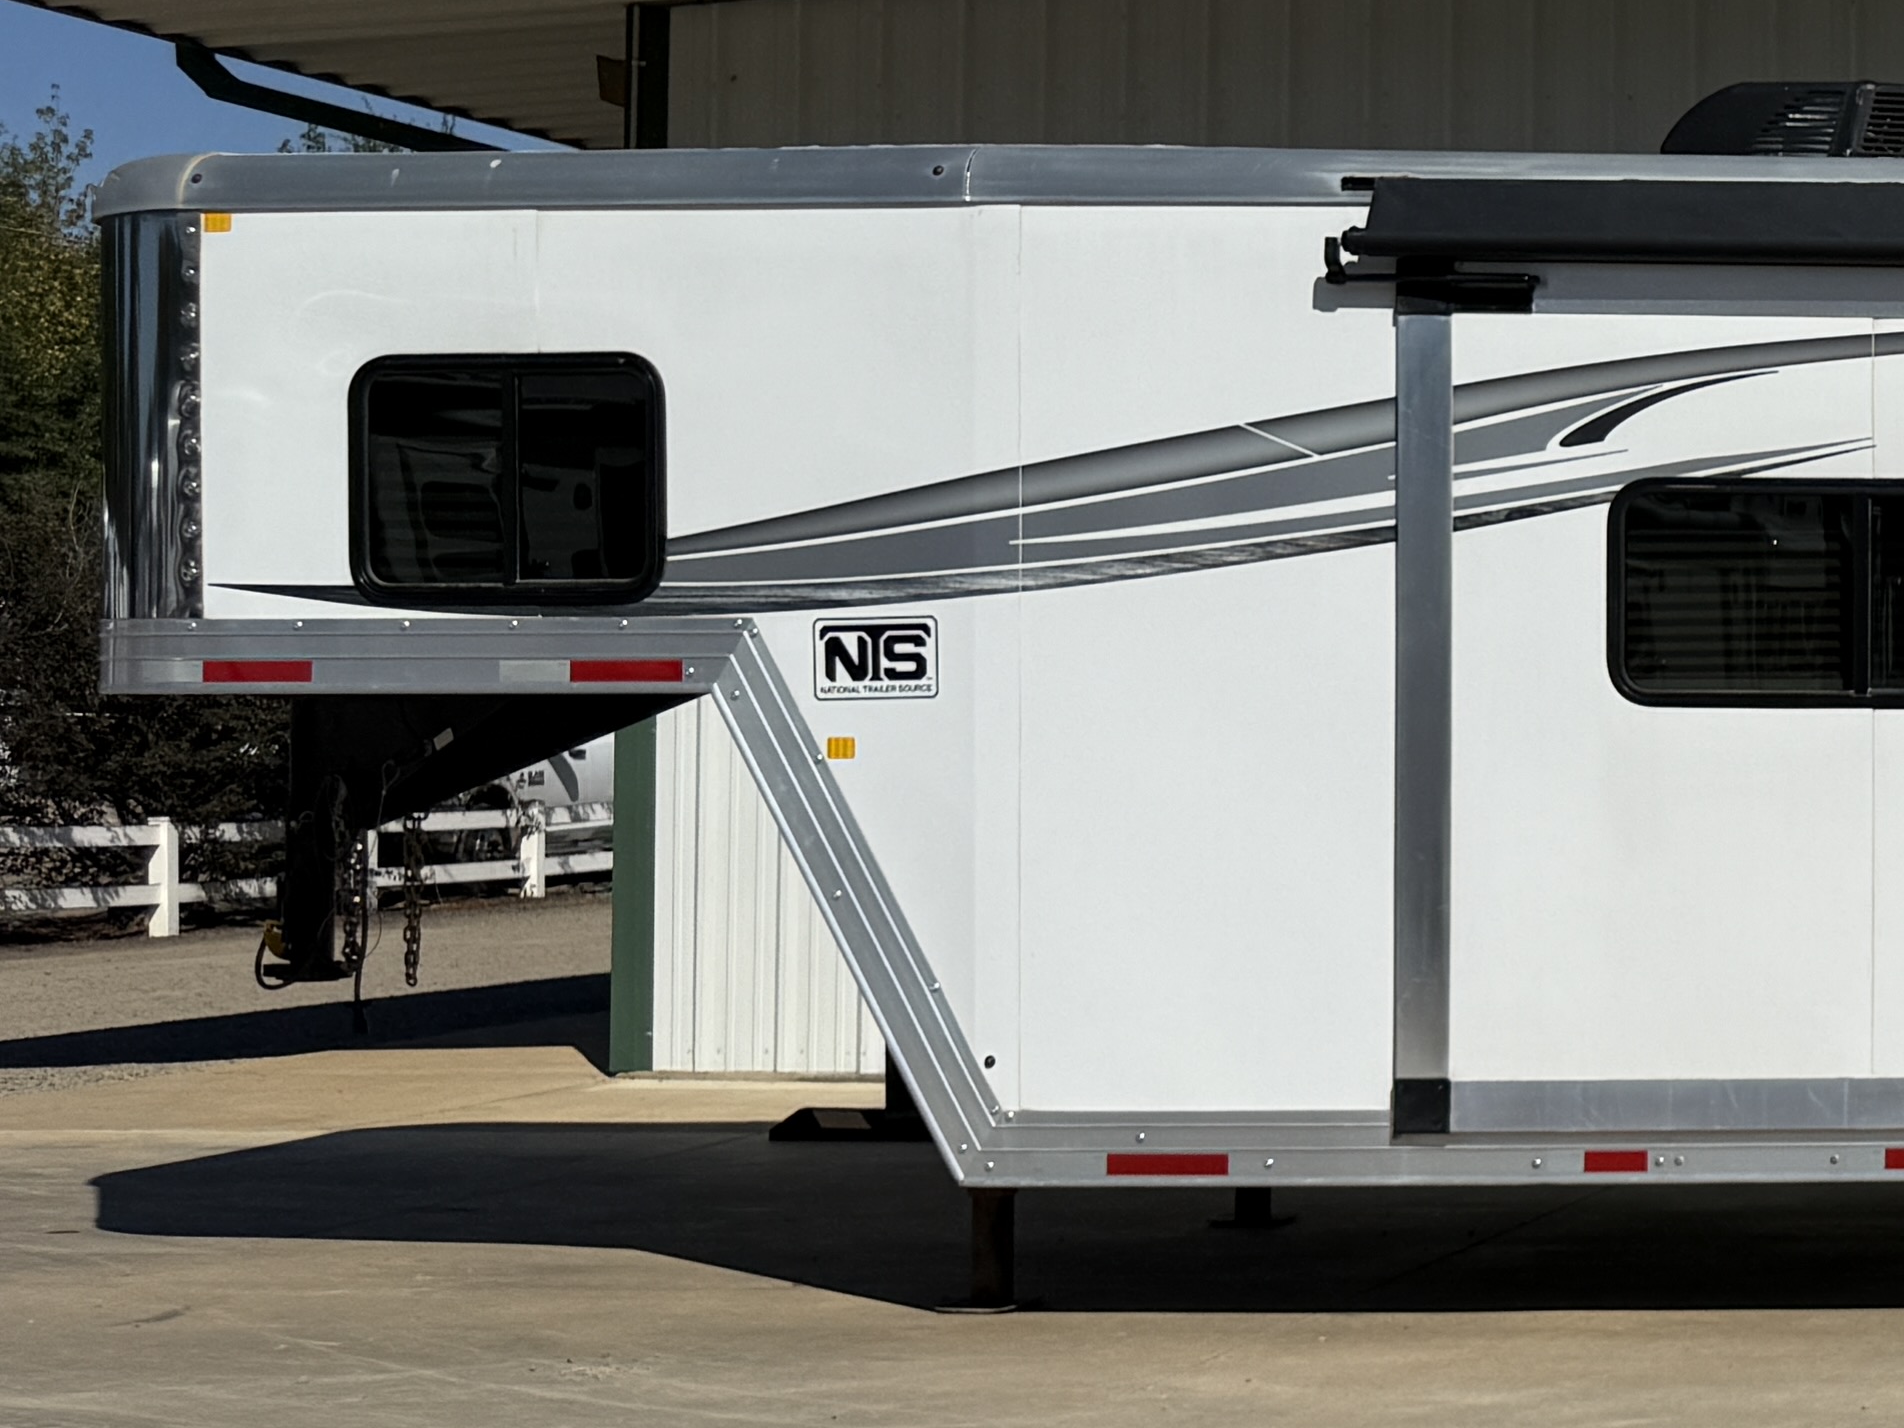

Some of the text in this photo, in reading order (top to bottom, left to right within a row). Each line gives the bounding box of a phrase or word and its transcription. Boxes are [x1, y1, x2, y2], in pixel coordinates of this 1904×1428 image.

[819, 623, 931, 682] NTS
[820, 684, 933, 694] NATIONAL TRAILER SOURCE
